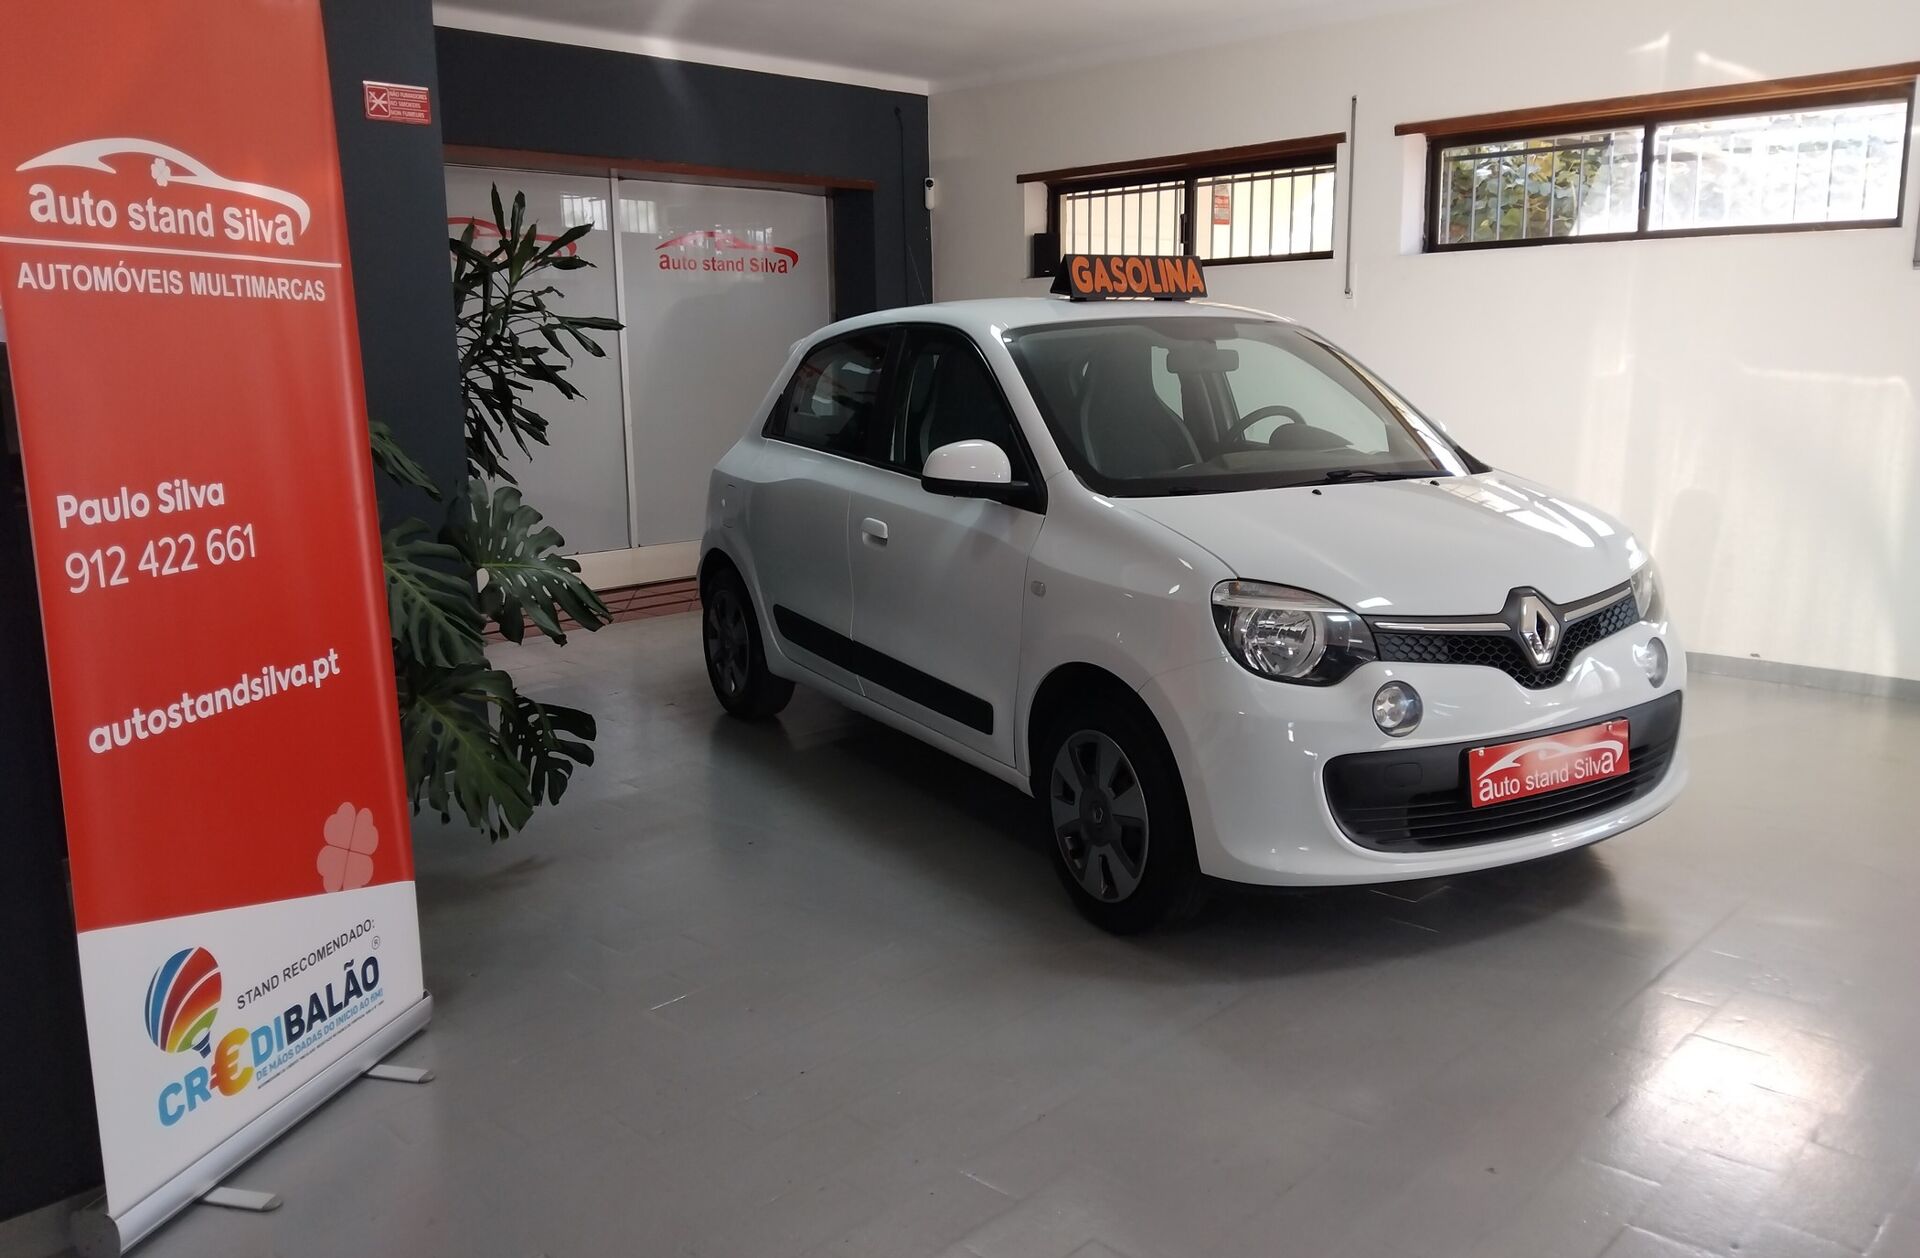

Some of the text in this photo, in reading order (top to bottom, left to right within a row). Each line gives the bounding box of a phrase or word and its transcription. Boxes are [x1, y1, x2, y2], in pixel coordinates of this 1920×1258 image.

[28, 184, 295, 246] auto stand Silva
[17, 260, 326, 302] AUTOMÓVEIS MULTIMARCAS
[659, 254, 788, 274] auto stand Silva
[1071, 256, 1205, 294] GASOLINA
[56, 478, 225, 529] Paulo Silva
[64, 523, 256, 594] 912 422 661
[88, 648, 341, 754] autostandsilva.pt
[1479, 751, 1614, 802] auto stand Silva
[236, 918, 376, 1010] STAND RECOMENDADO:
[256, 1068, 268, 1081] DE
[295, 1028, 323, 1055] DADAS
[324, 1020, 335, 1036] DO
